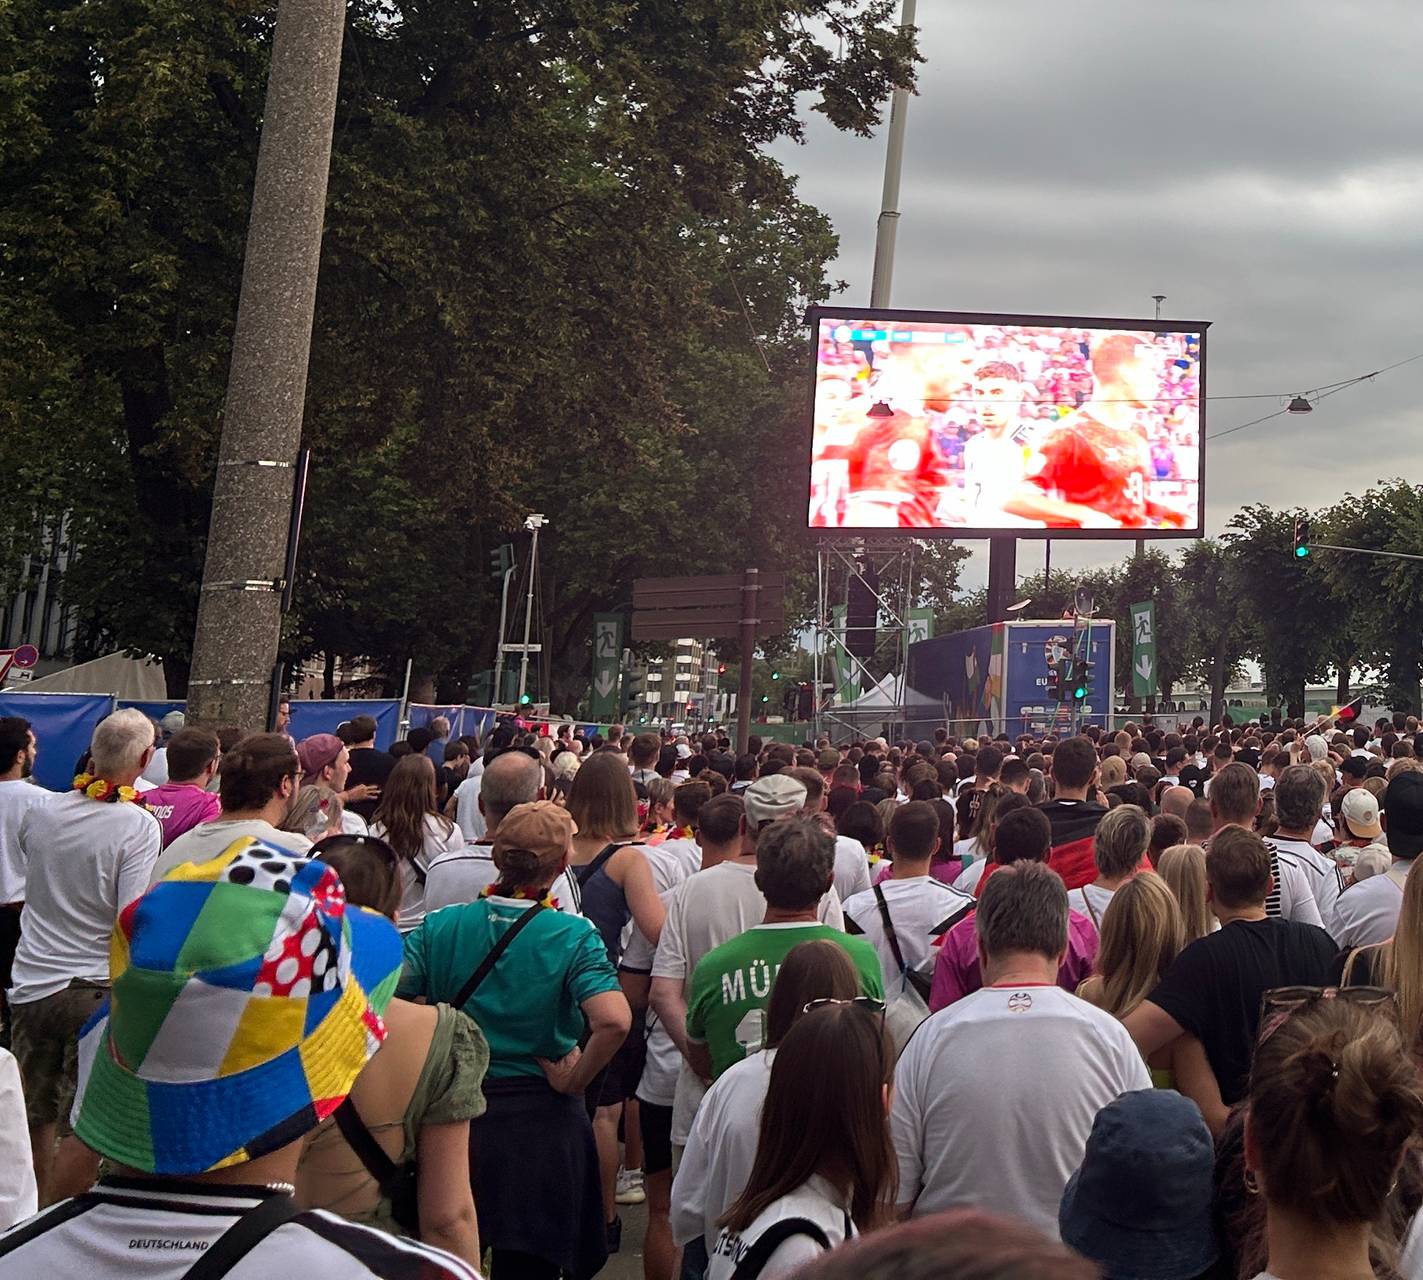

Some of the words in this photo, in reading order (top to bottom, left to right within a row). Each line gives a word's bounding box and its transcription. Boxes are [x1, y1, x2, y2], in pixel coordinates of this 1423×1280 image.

[1036, 678, 1048, 686] EU
[721, 959, 782, 1005] MÜ
[128, 1239, 209, 1250] DEUTSCHLAND
